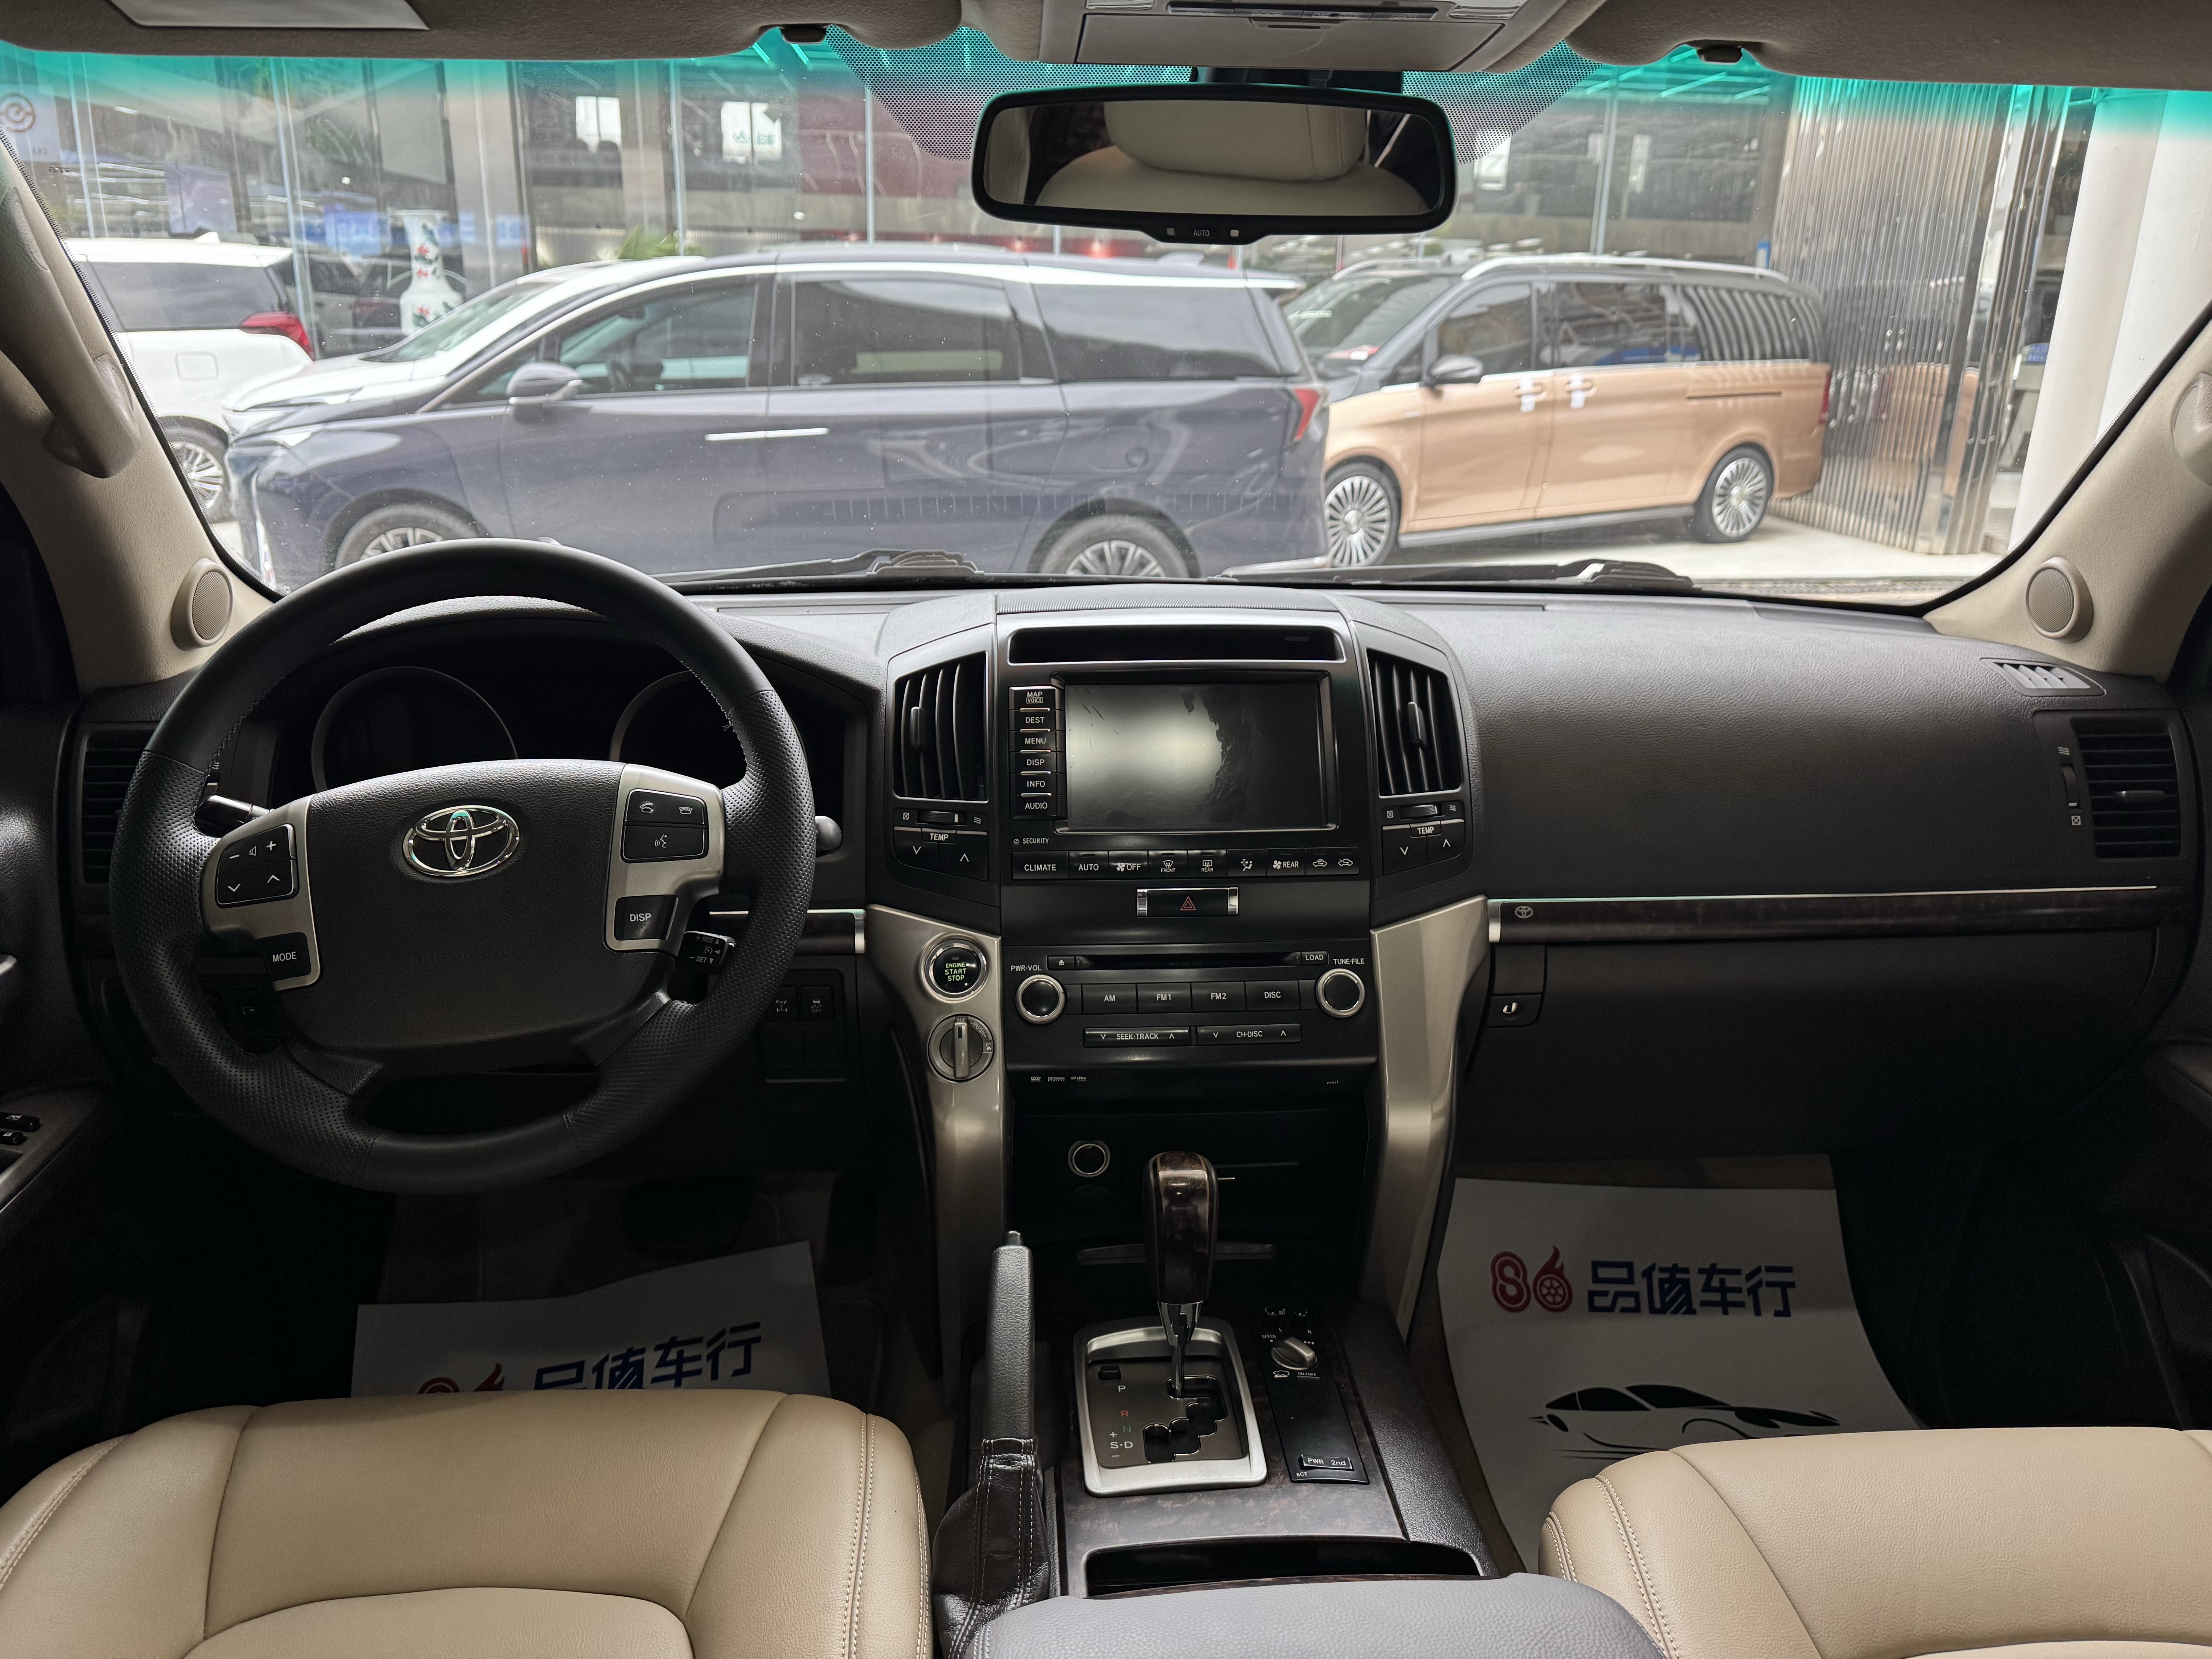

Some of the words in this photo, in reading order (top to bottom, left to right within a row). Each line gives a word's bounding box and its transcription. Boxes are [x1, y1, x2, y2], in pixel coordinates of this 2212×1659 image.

[630, 913, 651, 921] DISP
[273, 951, 297, 962] MODE
[1587, 1259, 1796, 1317] 品值车行
